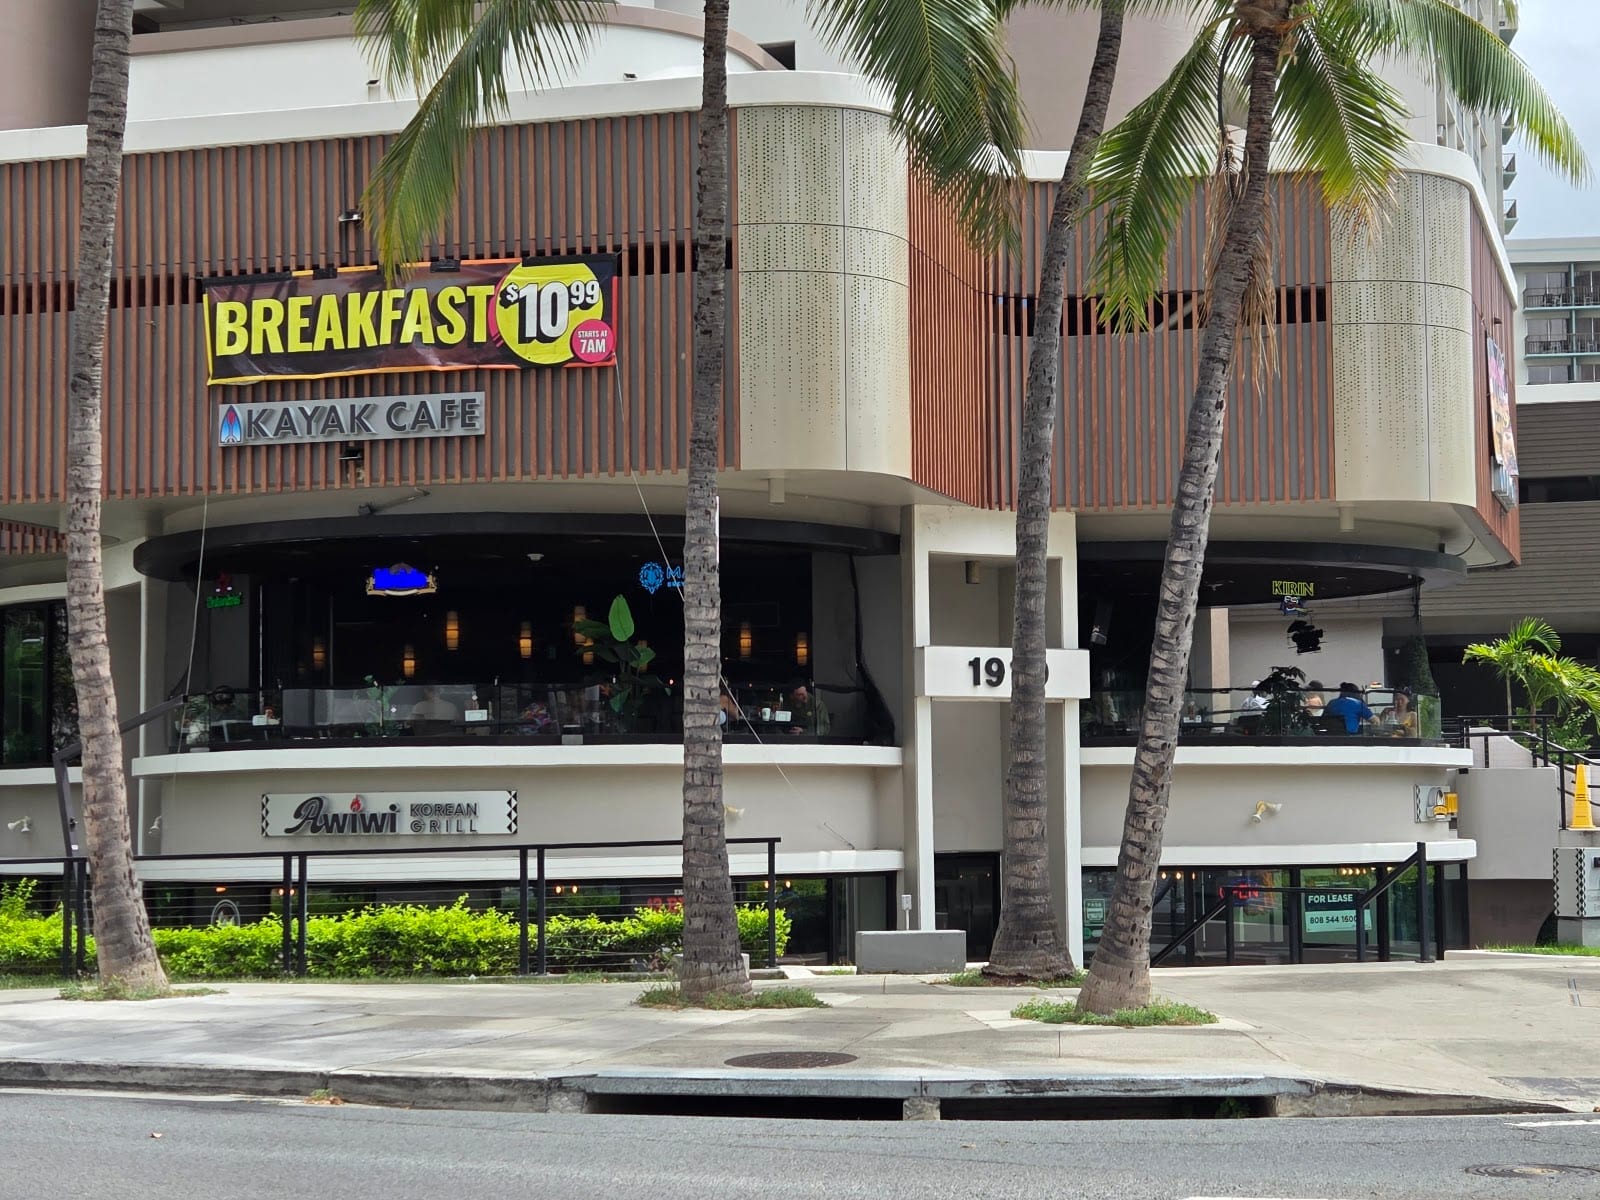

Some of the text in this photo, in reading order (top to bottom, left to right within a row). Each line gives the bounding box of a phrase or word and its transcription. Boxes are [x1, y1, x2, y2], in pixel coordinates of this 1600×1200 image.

[216, 285, 495, 356] BREAKFAST
[577, 330, 600, 338] STARTS
[580, 339, 606, 353] 7AM
[247, 398, 477, 438] KAYAK CAFE
[1272, 580, 1315, 596] KIRIN
[968, 656, 1050, 688] 19
[284, 796, 401, 834] Awiwi
[410, 803, 479, 817] KOREAN
[410, 819, 479, 833] GRILL
[1308, 894, 1353, 904] FOR LEASE
[1325, 915, 1339, 923] 544
